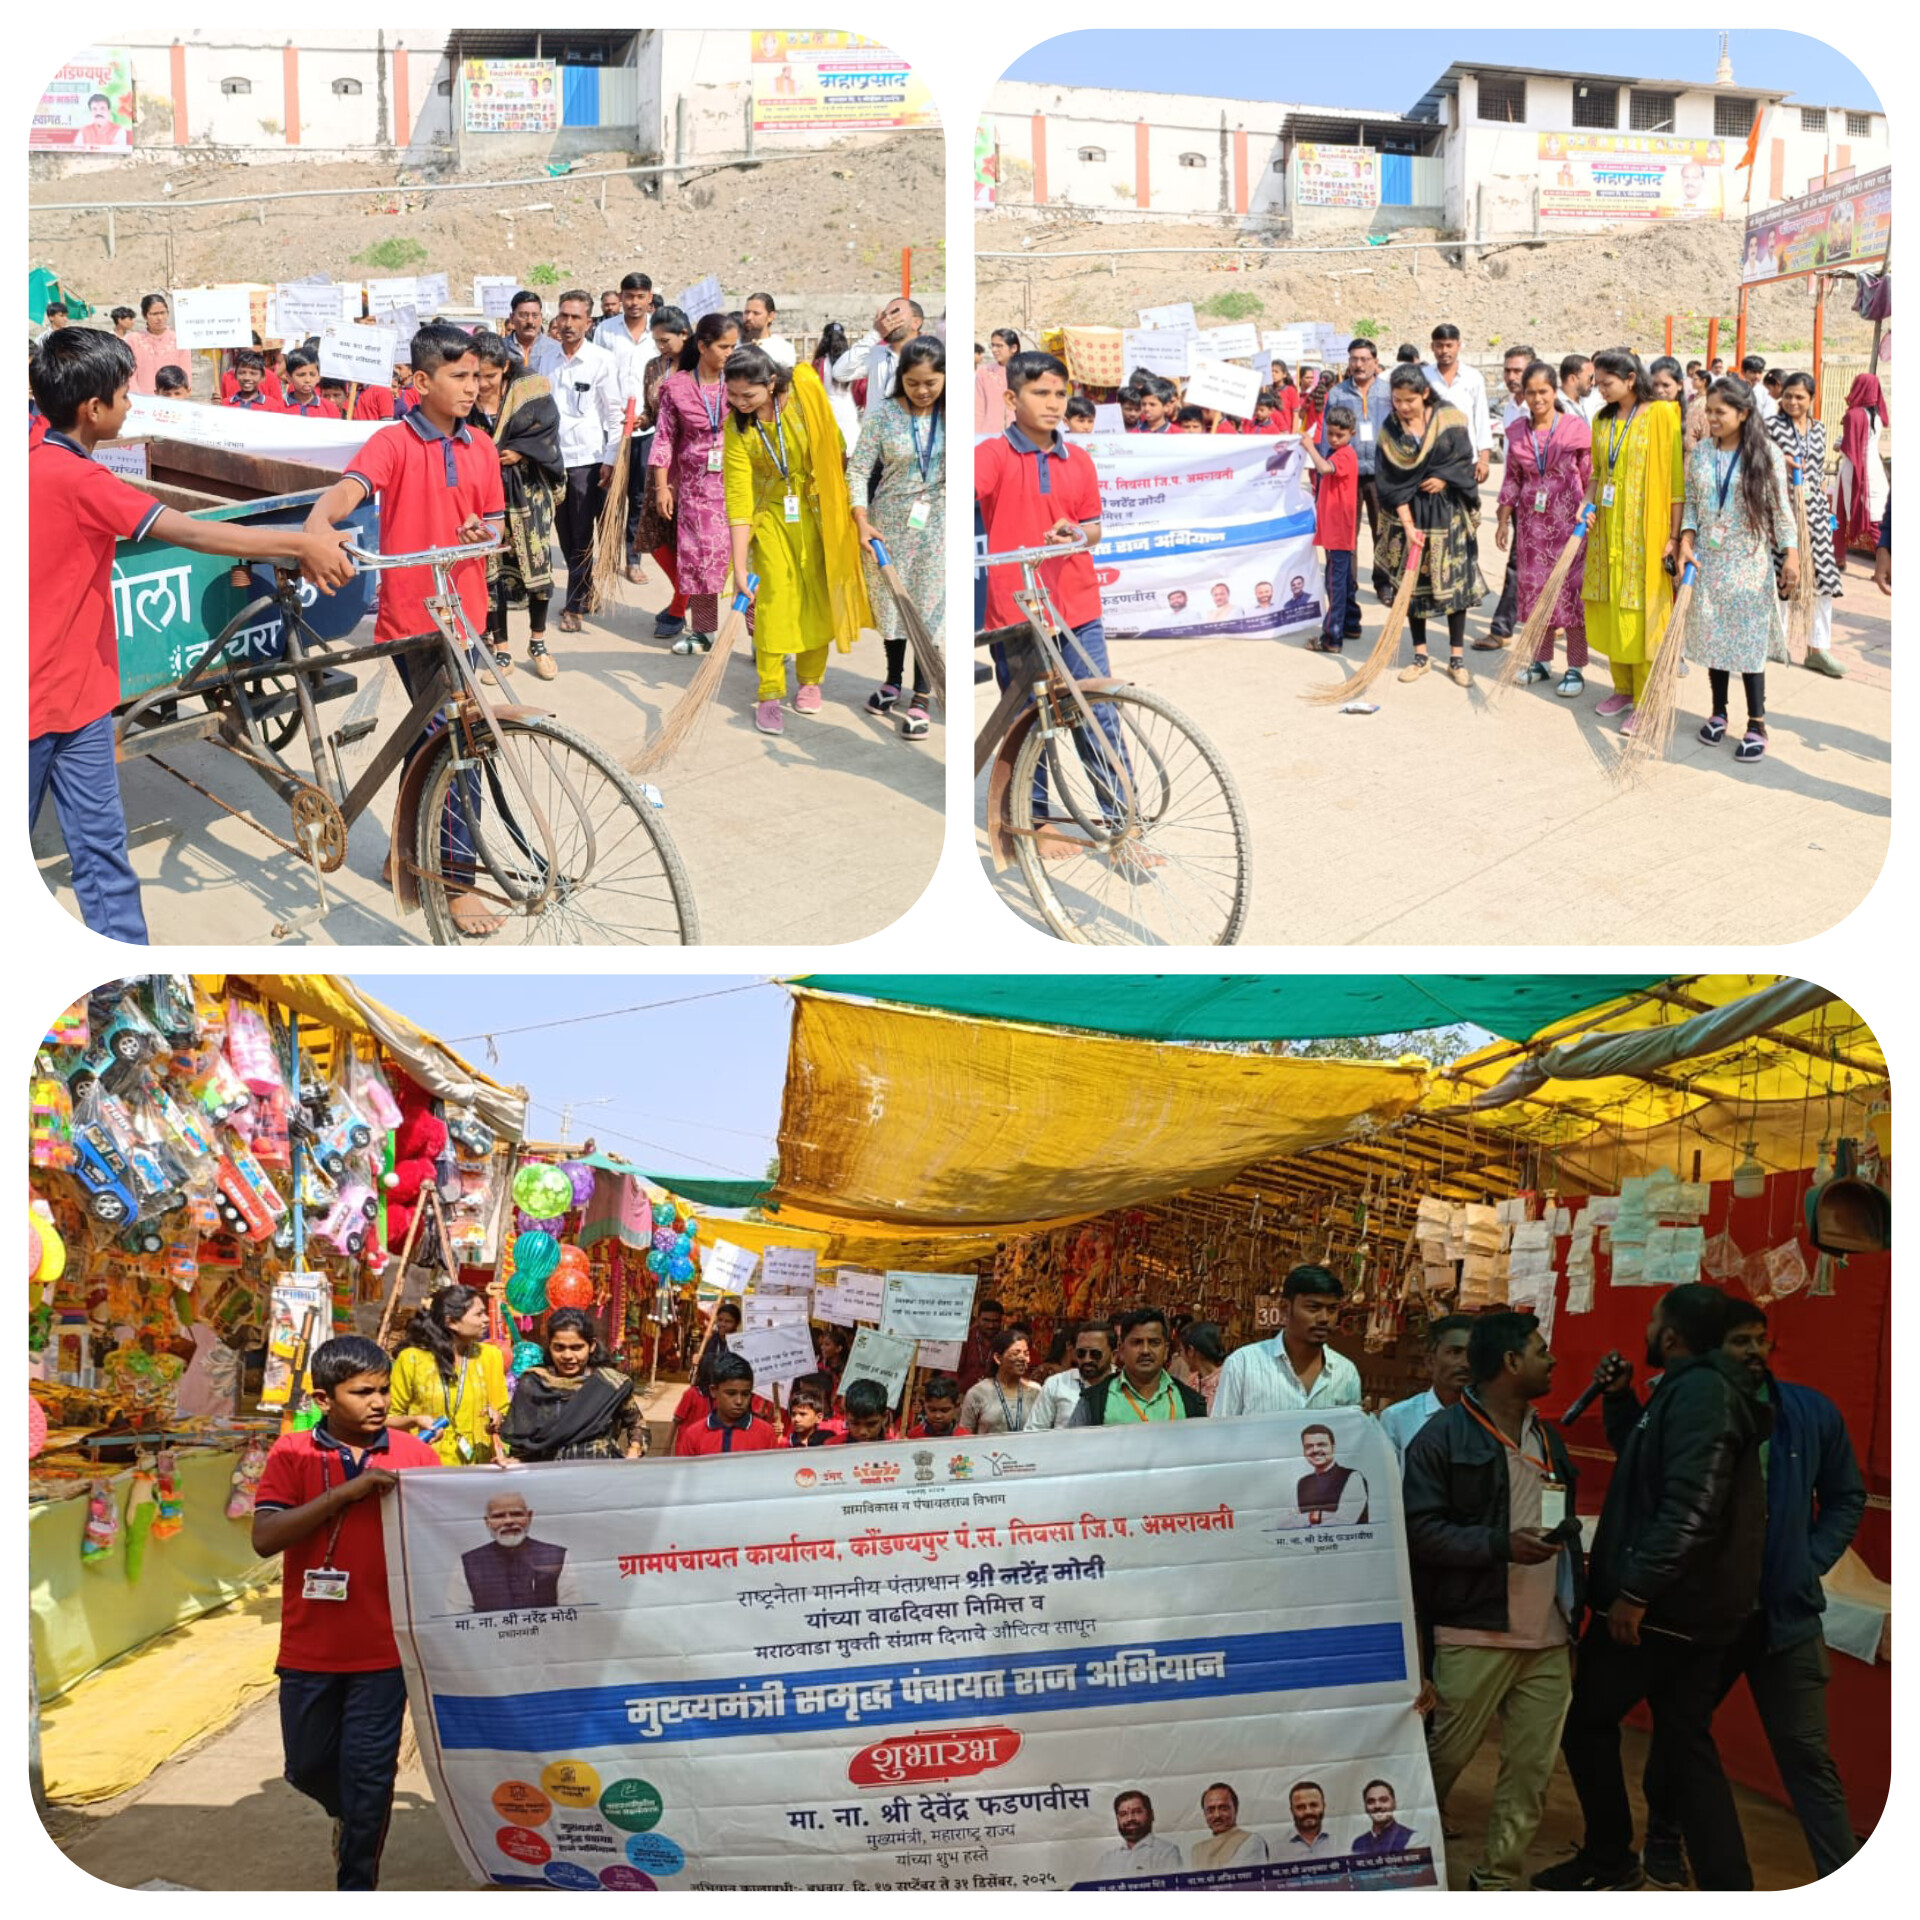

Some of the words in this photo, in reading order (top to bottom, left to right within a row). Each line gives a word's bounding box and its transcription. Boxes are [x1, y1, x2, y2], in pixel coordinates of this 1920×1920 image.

[817, 72, 909, 89] महाप्रसाद
[1591, 171, 1666, 186] महाप्रसाद
[1116, 476, 1151, 491] तिवसा
[1154, 474, 1182, 488] जि.प.
[1186, 467, 1234, 483] अमरावती
[1153, 529, 1227, 549] अभियान
[841, 1500, 899, 1516] ग्रामविकास
[902, 1501, 910, 1511] व
[913, 1495, 970, 1511] पंचायतराज
[973, 1492, 1007, 1507] विभाग
[618, 1545, 739, 1579] ग्रामपंचायत
[745, 1533, 843, 1566] कार्यालय,
[849, 1528, 949, 1562] कौंडण्यपुर
[955, 1521, 1003, 1550] पं.स.
[1009, 1517, 1075, 1545] तिवसा
[1079, 1512, 1135, 1542] जि.प.
[1142, 1503, 1235, 1536] अमरावती
[737, 1582, 807, 1610] राष्ट्रनेता
[813, 1577, 880, 1602] माननीय
[886, 1572, 961, 1596] पंतप्रधान
[966, 1562, 994, 1588] श्री
[999, 1560, 1048, 1587] नरेंद्र
[1052, 1554, 1105, 1581] मोदी
[455, 1619, 476, 1631] मा.
[479, 1616, 498, 1629] ना.
[501, 1612, 518, 1627] श्री
[522, 1610, 548, 1624] नरेंद्र
[551, 1607, 578, 1623] मोदी
[804, 1608, 861, 1630] यांच्या
[867, 1599, 959, 1626] वाढदिवसा
[965, 1592, 1024, 1617] निमित्त
[1030, 1594, 1045, 1612] व
[754, 1639, 831, 1660] मराठवाडा
[838, 1633, 879, 1660] मुक्ती
[886, 1629, 933, 1650] संग्राम
[938, 1622, 986, 1647] दिनाचे
[991, 1619, 1049, 1641] औचित्य
[1055, 1617, 1097, 1642] साधून
[624, 1680, 787, 1738] मुख्यमंत्री
[792, 1678, 894, 1722] समृद्ध
[899, 1667, 1006, 1704] पंचायत
[1011, 1663, 1078, 1696] राज
[1086, 1648, 1227, 1689] अभियान
[870, 1733, 999, 1782] शुभारंभ
[786, 1809, 825, 1831] मा.
[833, 1805, 870, 1829] ना.
[880, 1799, 910, 1825] श्री
[917, 1792, 969, 1823] देवेंद्र
[975, 1782, 1091, 1816] फडणवीस
[865, 1829, 927, 1852] मुख्यमंत्री,
[931, 1826, 981, 1848] महाराष्ट्र
[985, 1823, 1016, 1842] राज्य
[895, 1851, 933, 1867] यांच्या
[937, 1849, 960, 1869] शुभ
[963, 1844, 989, 1864] हस्ते
[896, 1877, 935, 1892] सप्टेंबर
[938, 1876, 950, 1891] ते
[972, 1873, 1018, 1889] डिसेंबर,
[1022, 1872, 1057, 1886] २०२५
